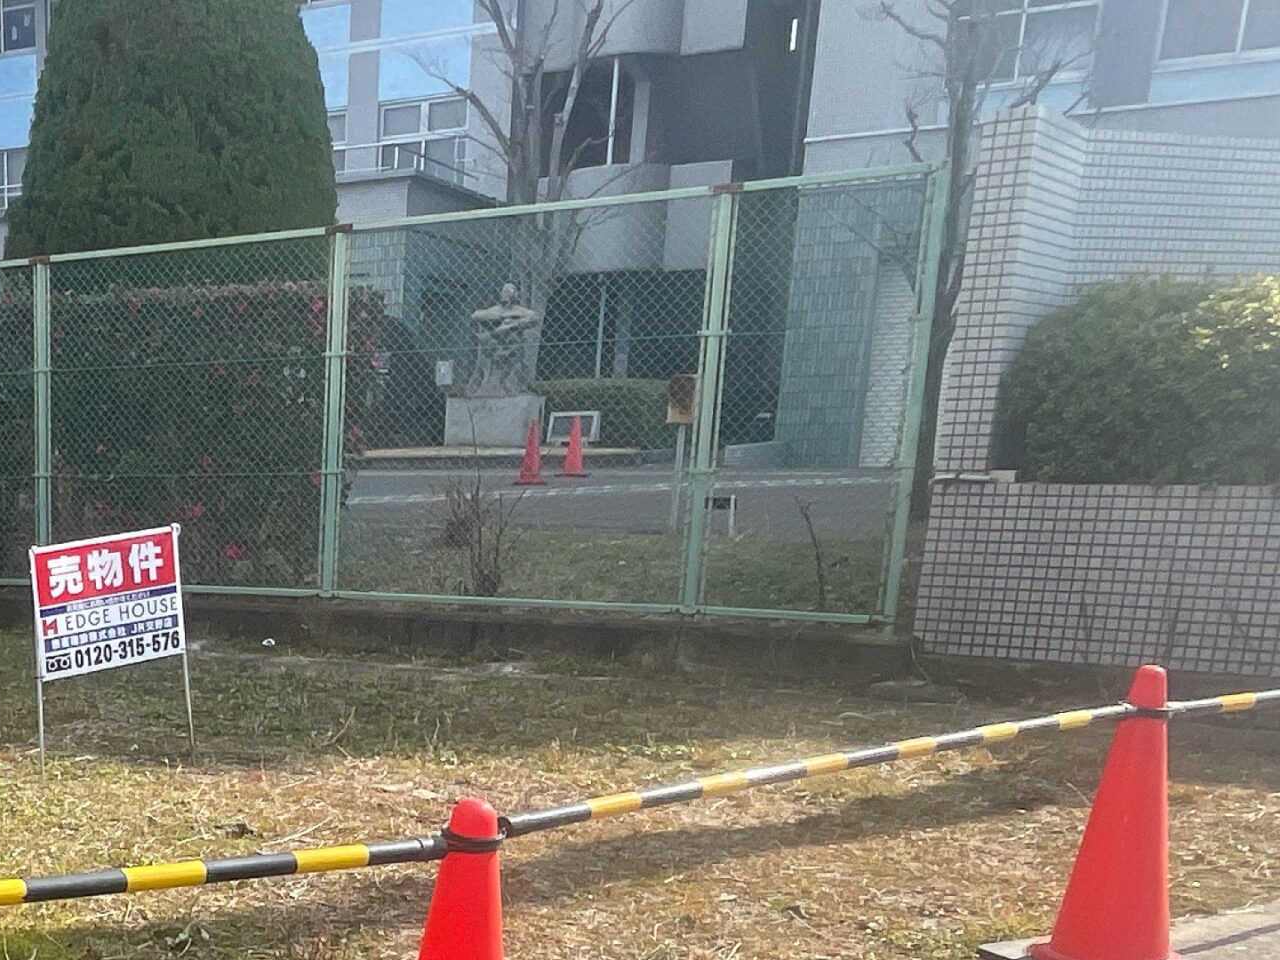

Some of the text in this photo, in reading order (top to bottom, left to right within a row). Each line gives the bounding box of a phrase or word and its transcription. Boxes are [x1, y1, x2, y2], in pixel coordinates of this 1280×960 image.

[47, 541, 164, 598] 売物件
[66, 596, 177, 631] EDGE HOUSE
[75, 630, 180, 668] 0120-315-576
